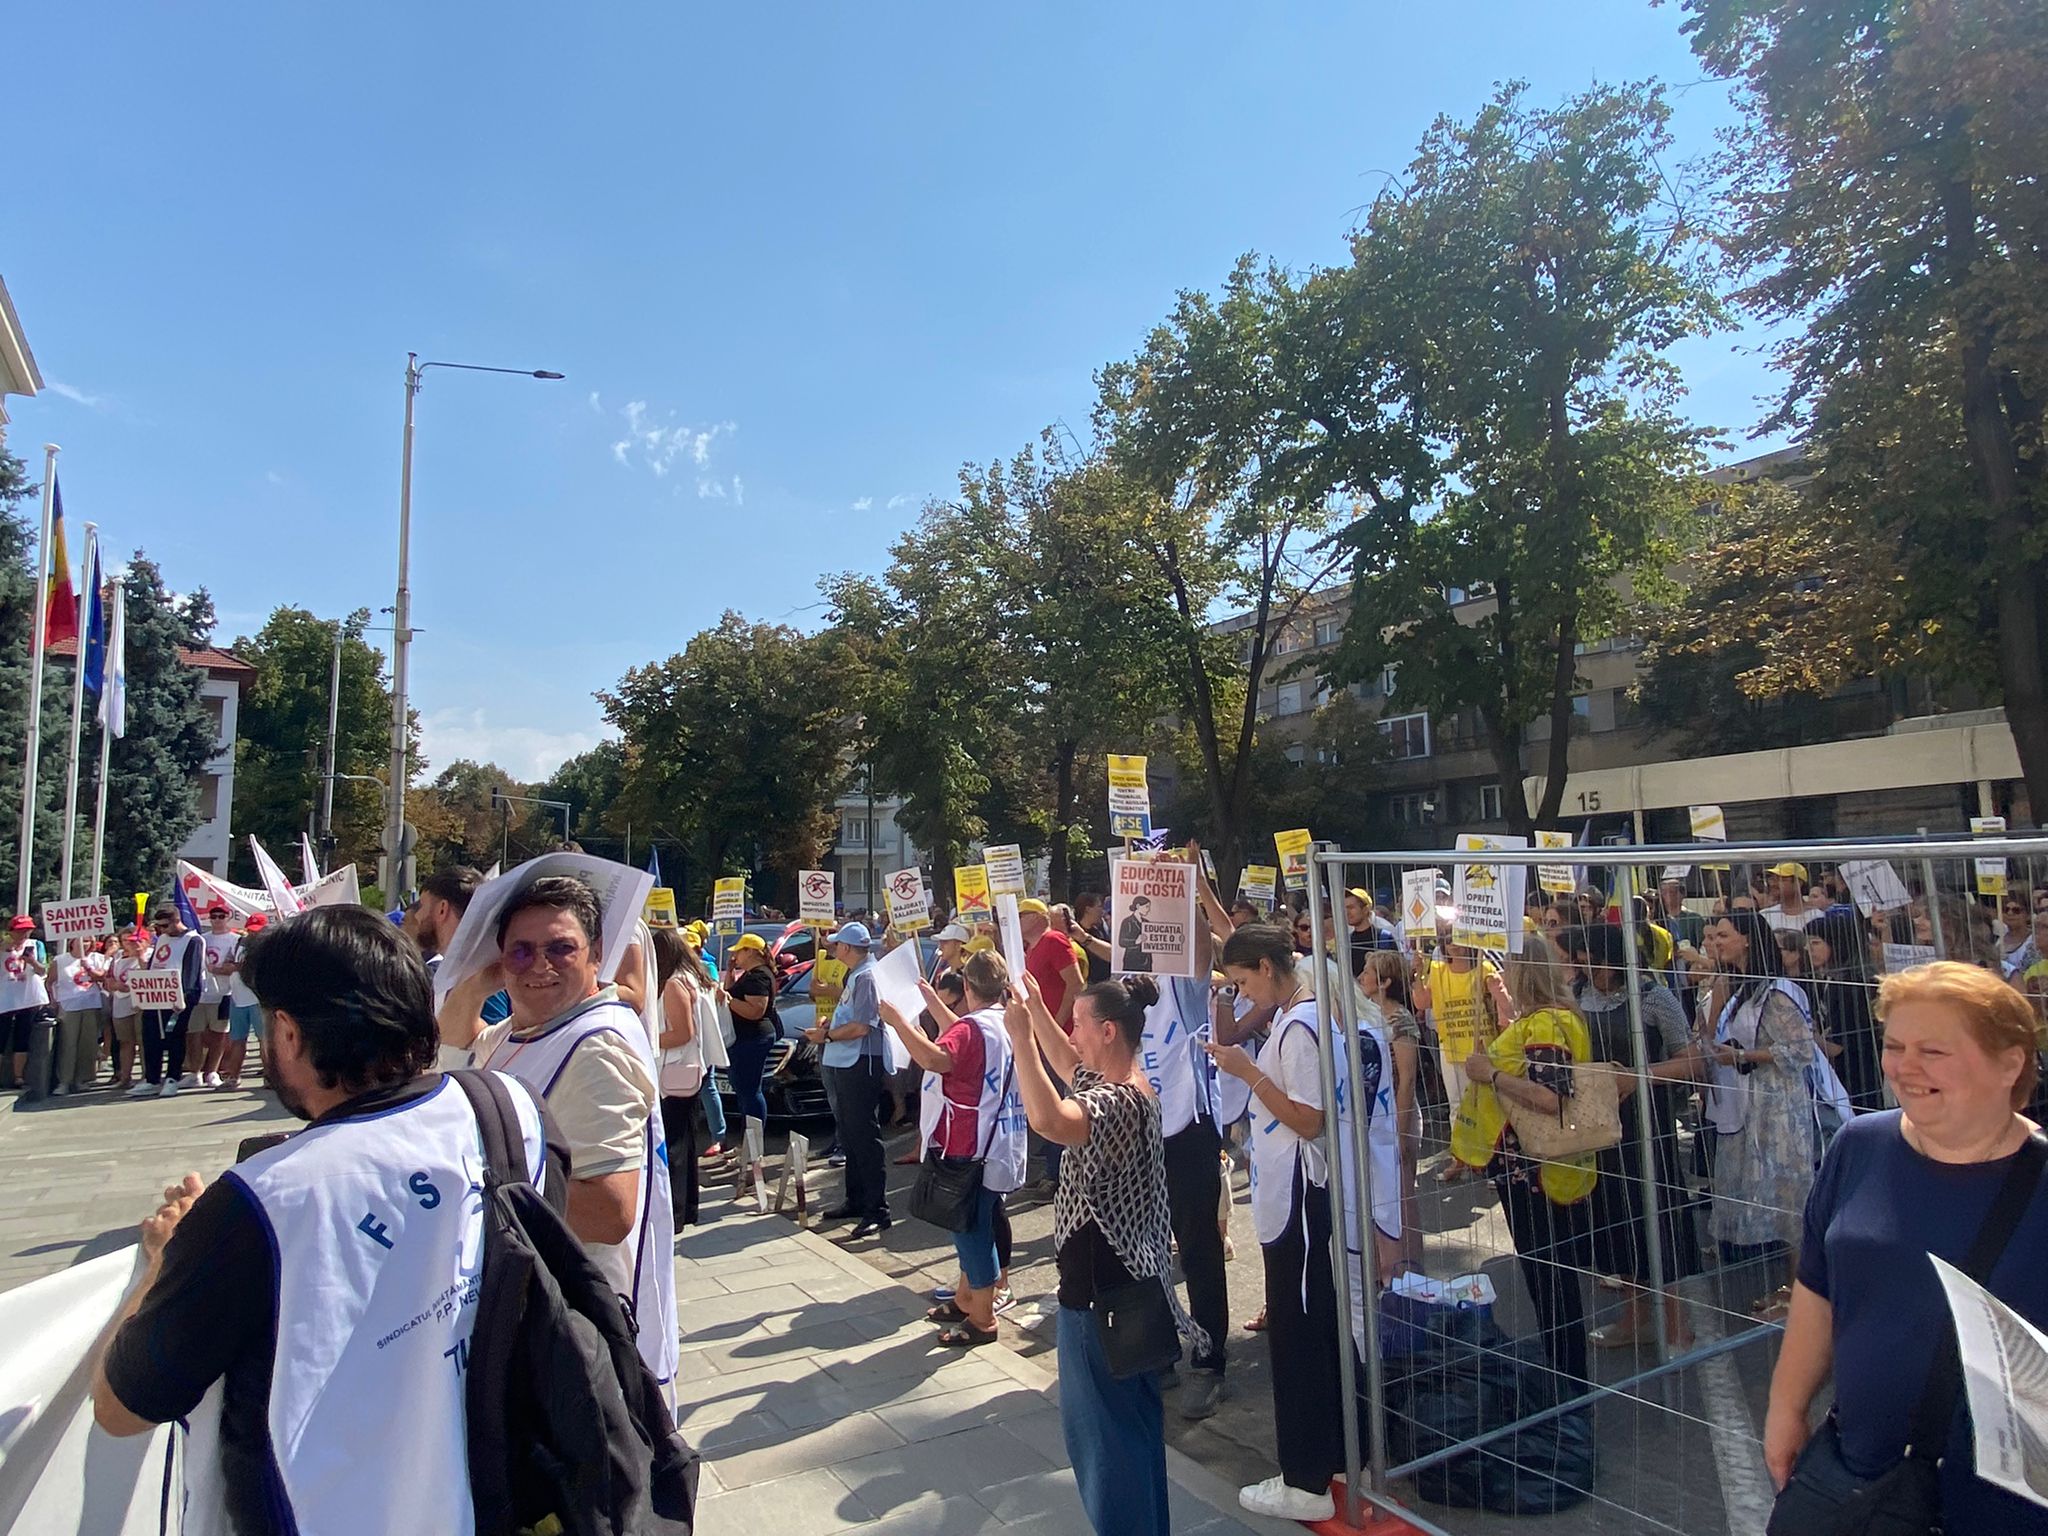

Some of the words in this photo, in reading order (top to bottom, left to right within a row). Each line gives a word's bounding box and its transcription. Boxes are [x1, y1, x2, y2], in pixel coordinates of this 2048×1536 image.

[1578, 791, 1601, 812] 15
[1120, 881, 1139, 895] NU
[46, 903, 108, 922] SANITAS
[1149, 933, 1168, 942] ESTE
[1169, 934, 1175, 943] O
[131, 977, 179, 990] SANITAS
[376, 1310, 432, 1351] SINDICATUL
